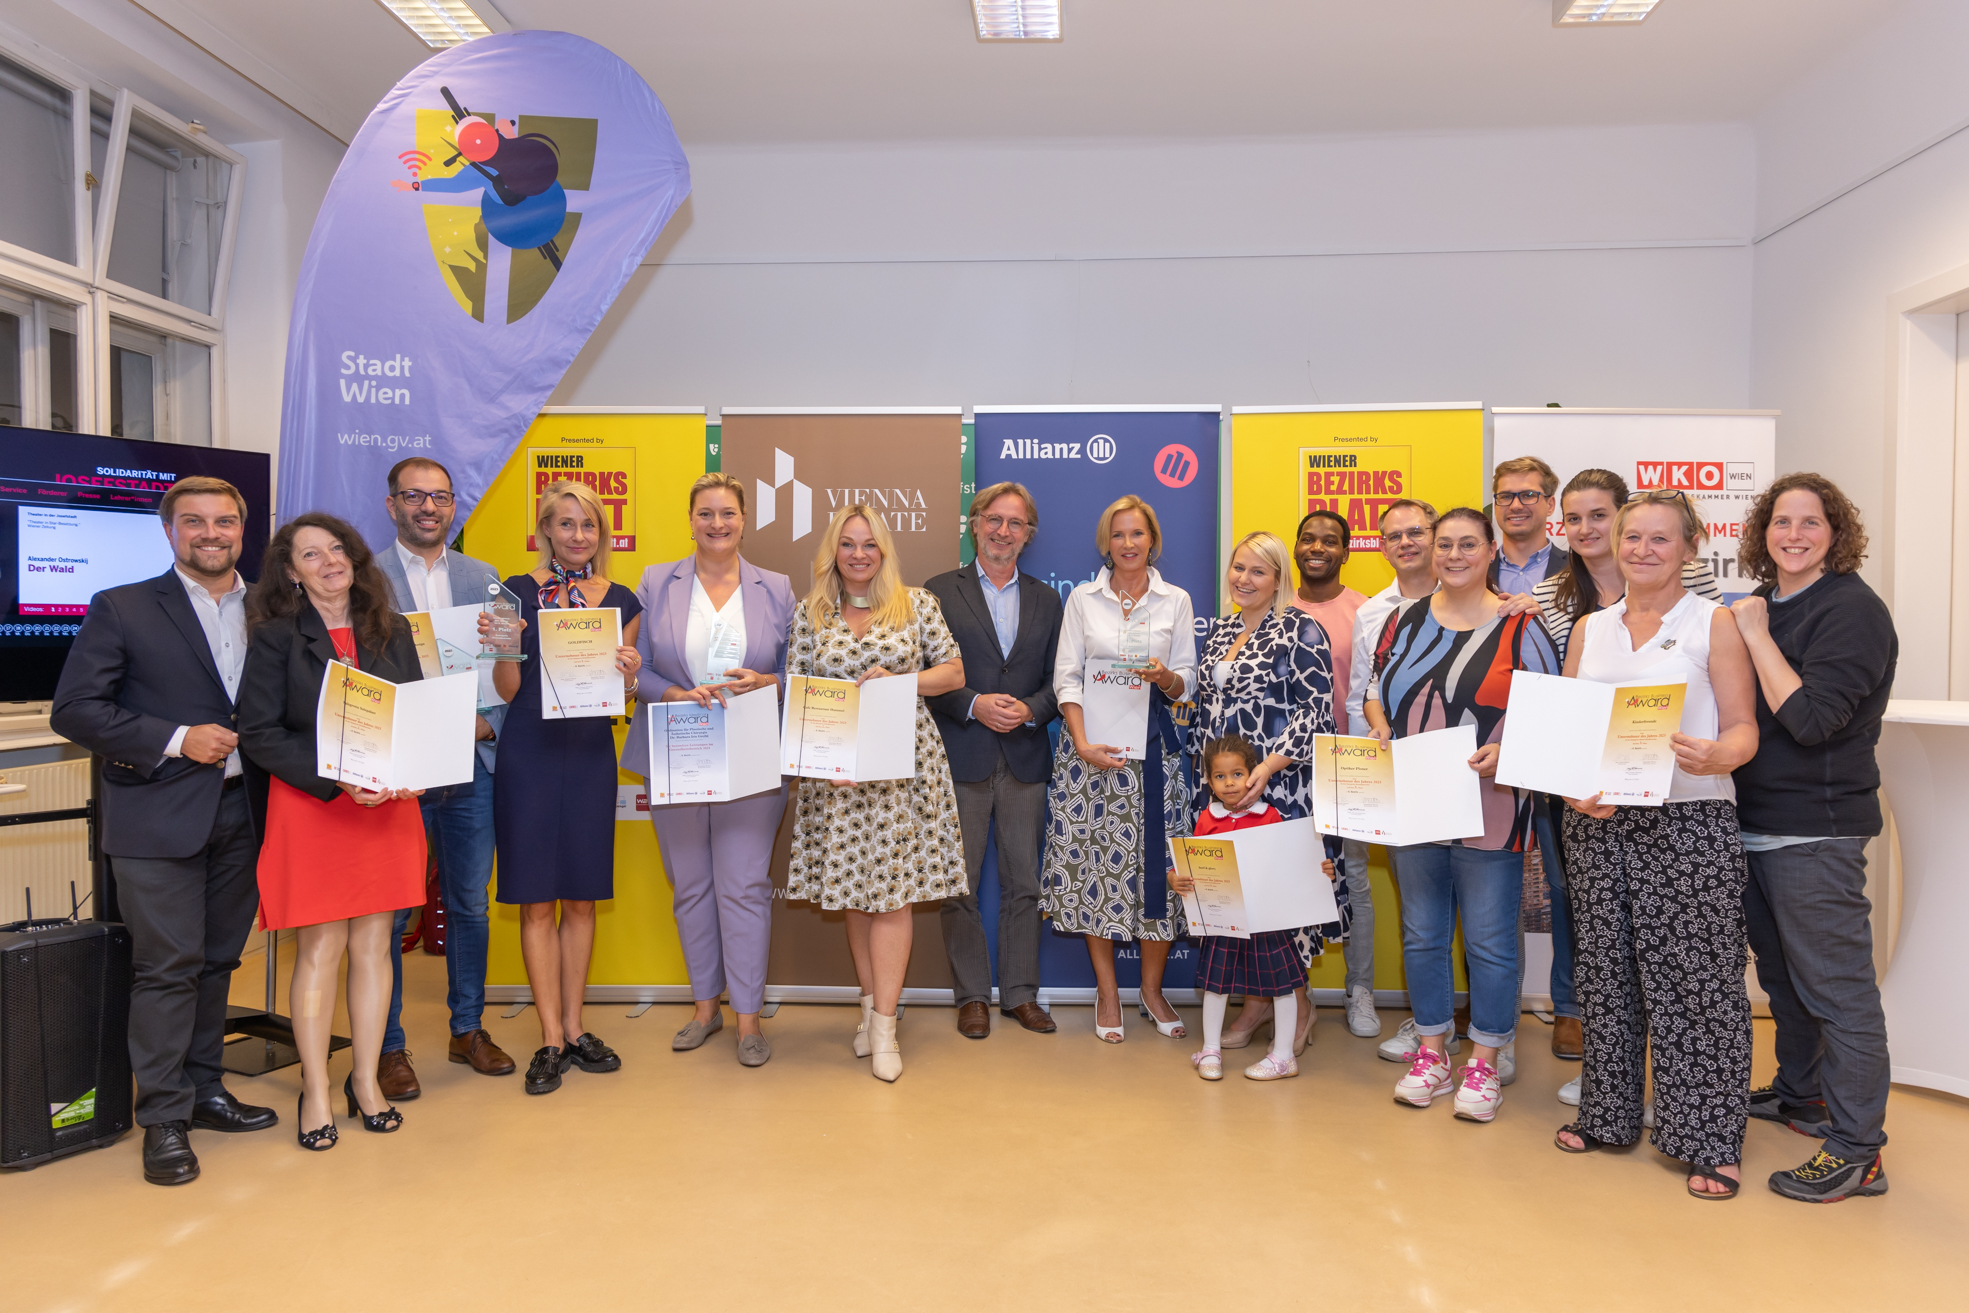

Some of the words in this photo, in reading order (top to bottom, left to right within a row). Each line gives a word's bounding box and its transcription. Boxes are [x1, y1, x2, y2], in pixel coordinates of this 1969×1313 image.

[341, 351, 412, 377] Stadt
[340, 379, 410, 405] Wien
[338, 430, 432, 452] wien.gv.at
[1370, 436, 1378, 444] by
[1000, 439, 1081, 459] Allianz
[537, 455, 584, 468] WIENER
[1309, 454, 1357, 468] WIENER
[97, 467, 158, 480] SOLIDARITÄT
[159, 473, 176, 481] MIT
[1638, 465, 1720, 486] WKO
[1308, 470, 1403, 496] BEZIRKS
[0, 486, 28, 494] Service
[38, 489, 68, 497] Förderer
[825, 488, 928, 508] VIENNA
[28, 564, 47, 572] Der
[49, 565, 74, 574] Wald
[557, 618, 602, 631] Award
[342, 678, 382, 701] Award
[805, 685, 846, 699] Award
[1626, 694, 1671, 708] Award
[668, 714, 709, 725] Award
[1332, 744, 1377, 757] Award
[1186, 846, 1223, 858] Award
